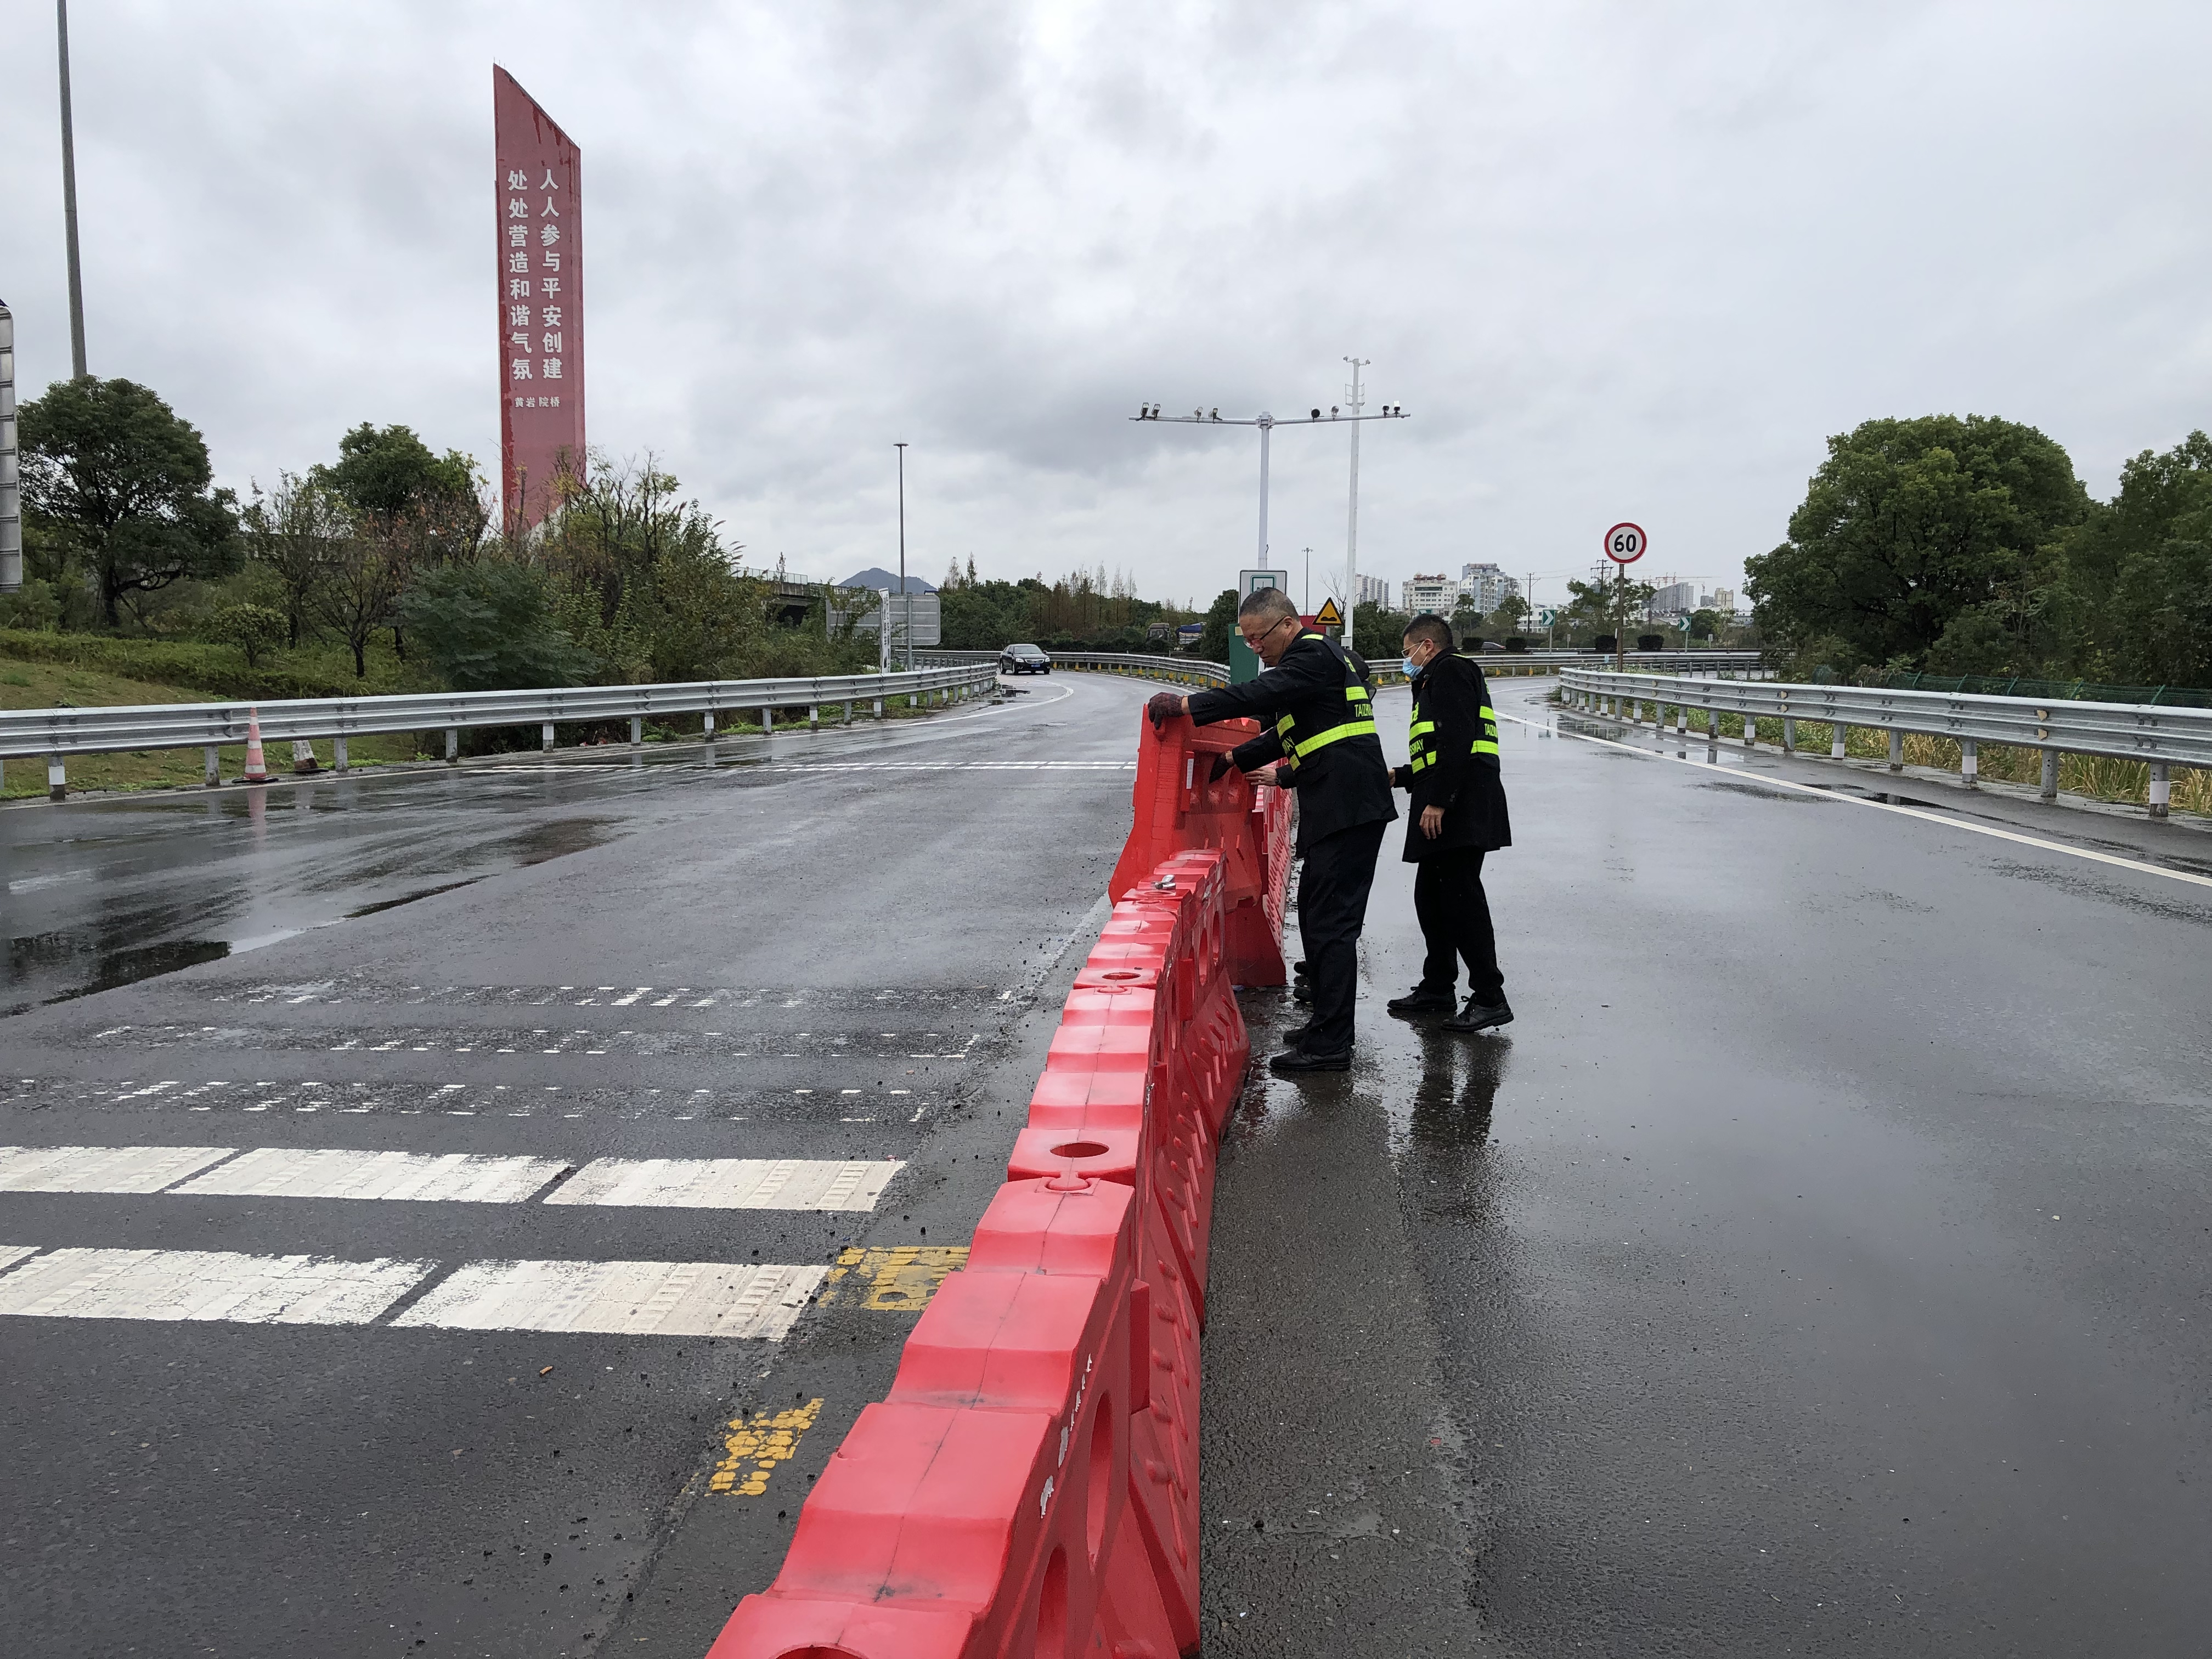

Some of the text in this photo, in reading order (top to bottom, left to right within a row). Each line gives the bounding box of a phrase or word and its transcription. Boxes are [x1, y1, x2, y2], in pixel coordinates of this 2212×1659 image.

[507, 170, 533, 380] 处处营造和谐气氛
[539, 168, 563, 380] 人人参与平安创建
[1614, 534, 1637, 552] 60
